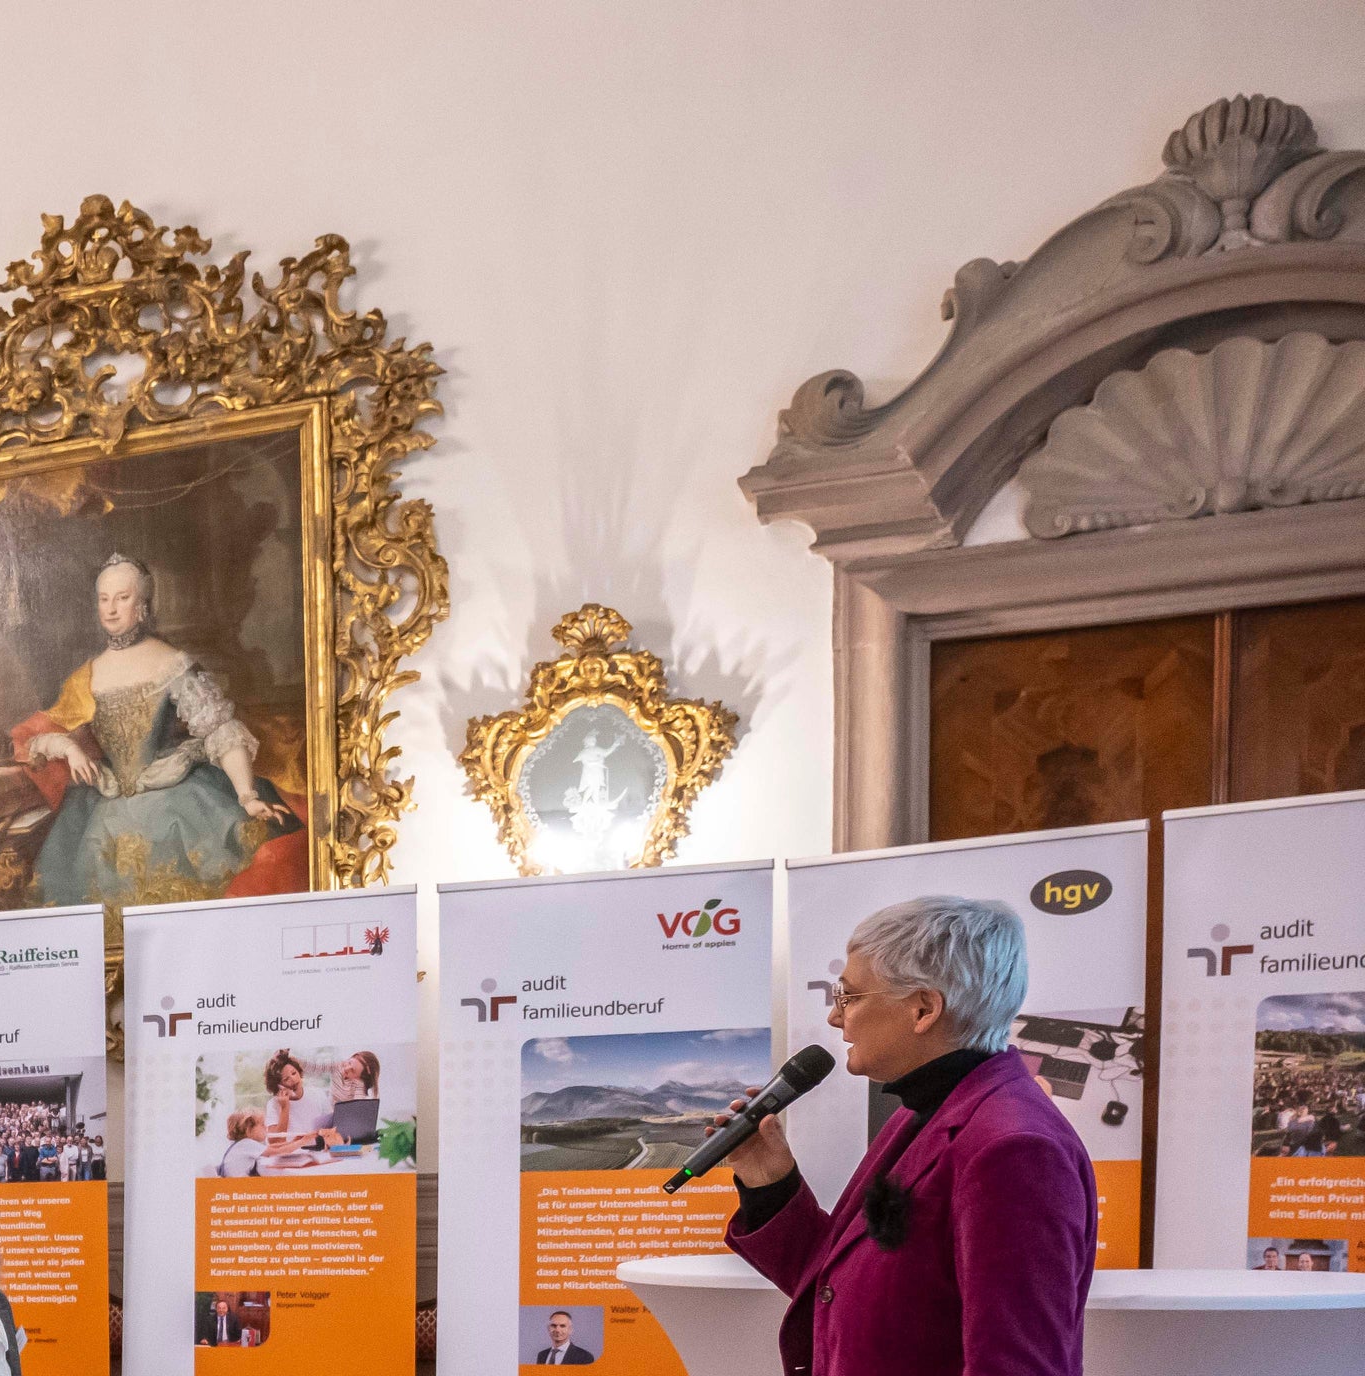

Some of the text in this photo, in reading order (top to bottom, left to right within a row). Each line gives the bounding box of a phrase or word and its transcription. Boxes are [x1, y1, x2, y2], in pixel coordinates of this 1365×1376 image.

[1044, 881, 1100, 908] hgv
[1260, 919, 1315, 940] audit
[662, 940, 736, 950] Home of apples
[522, 975, 567, 992] audit
[196, 993, 236, 1008] audit
[523, 998, 665, 1020] familieundberuf
[197, 1014, 322, 1035] familieundberuf
[233, 1192, 267, 1200] Balance
[270, 1191, 311, 1199] zwischen
[314, 1191, 347, 1199] Familie
[350, 1190, 368, 1198] und
[561, 1186, 612, 1195] Teilnahme
[615, 1187, 631, 1195] am
[634, 1185, 659, 1194] audit
[1270, 1193, 1325, 1203] zwischen
[211, 1203, 384, 1213] Beruf ist nicht immer einfach, aber sie
[538, 1201, 549, 1209] ist
[552, 1201, 566, 1209] für
[600, 1199, 668, 1208] Unternehmen
[671, 1199, 687, 1207] ein
[23, 1210, 42, 1218] Weg
[537, 1214, 583, 1224] wichtiger
[586, 1213, 619, 1222] Schritt
[622, 1214, 638, 1222] zur
[641, 1213, 683, 1223] Bindung
[1269, 1209, 1347, 1220] eine Sinfonie
[211, 1216, 373, 1226] ist essenziell für ein erfülltes Leben.
[211, 1230, 259, 1239] Schließlich
[261, 1230, 280, 1238] sind
[312, 1229, 360, 1238] Menschen,
[362, 1229, 377, 1237] die
[537, 1227, 615, 1237] Mitarbeitenden,
[618, 1227, 634, 1236] die
[636, 1226, 661, 1235] aktiv
[683, 1226, 723, 1234] Prozess
[22, 1234, 51, 1242] weiter.
[229, 1243, 273, 1252] umgeben,
[275, 1243, 290, 1251] die
[311, 1242, 363, 1251] motivieren,
[537, 1239, 670, 1250] teilnehmen und sich selbst
[36, 1246, 80, 1255] wichtigste
[61, 1259, 85, 1267] jeden
[211, 1256, 235, 1264] unser
[238, 1255, 268, 1263] Bestes
[283, 1255, 311, 1265] geben
[322, 1255, 355, 1263] sowohl
[369, 1254, 384, 1262] der
[537, 1254, 613, 1263] können. Zudem
[211, 1267, 300, 1277] Karriere als auch im
[536, 1267, 579, 1276] dass das
[536, 1282, 561, 1290] neue
[26, 1295, 77, 1304] bestmöglich
[276, 1291, 330, 1300] Peter Volgger
[611, 1305, 639, 1314] Walter
